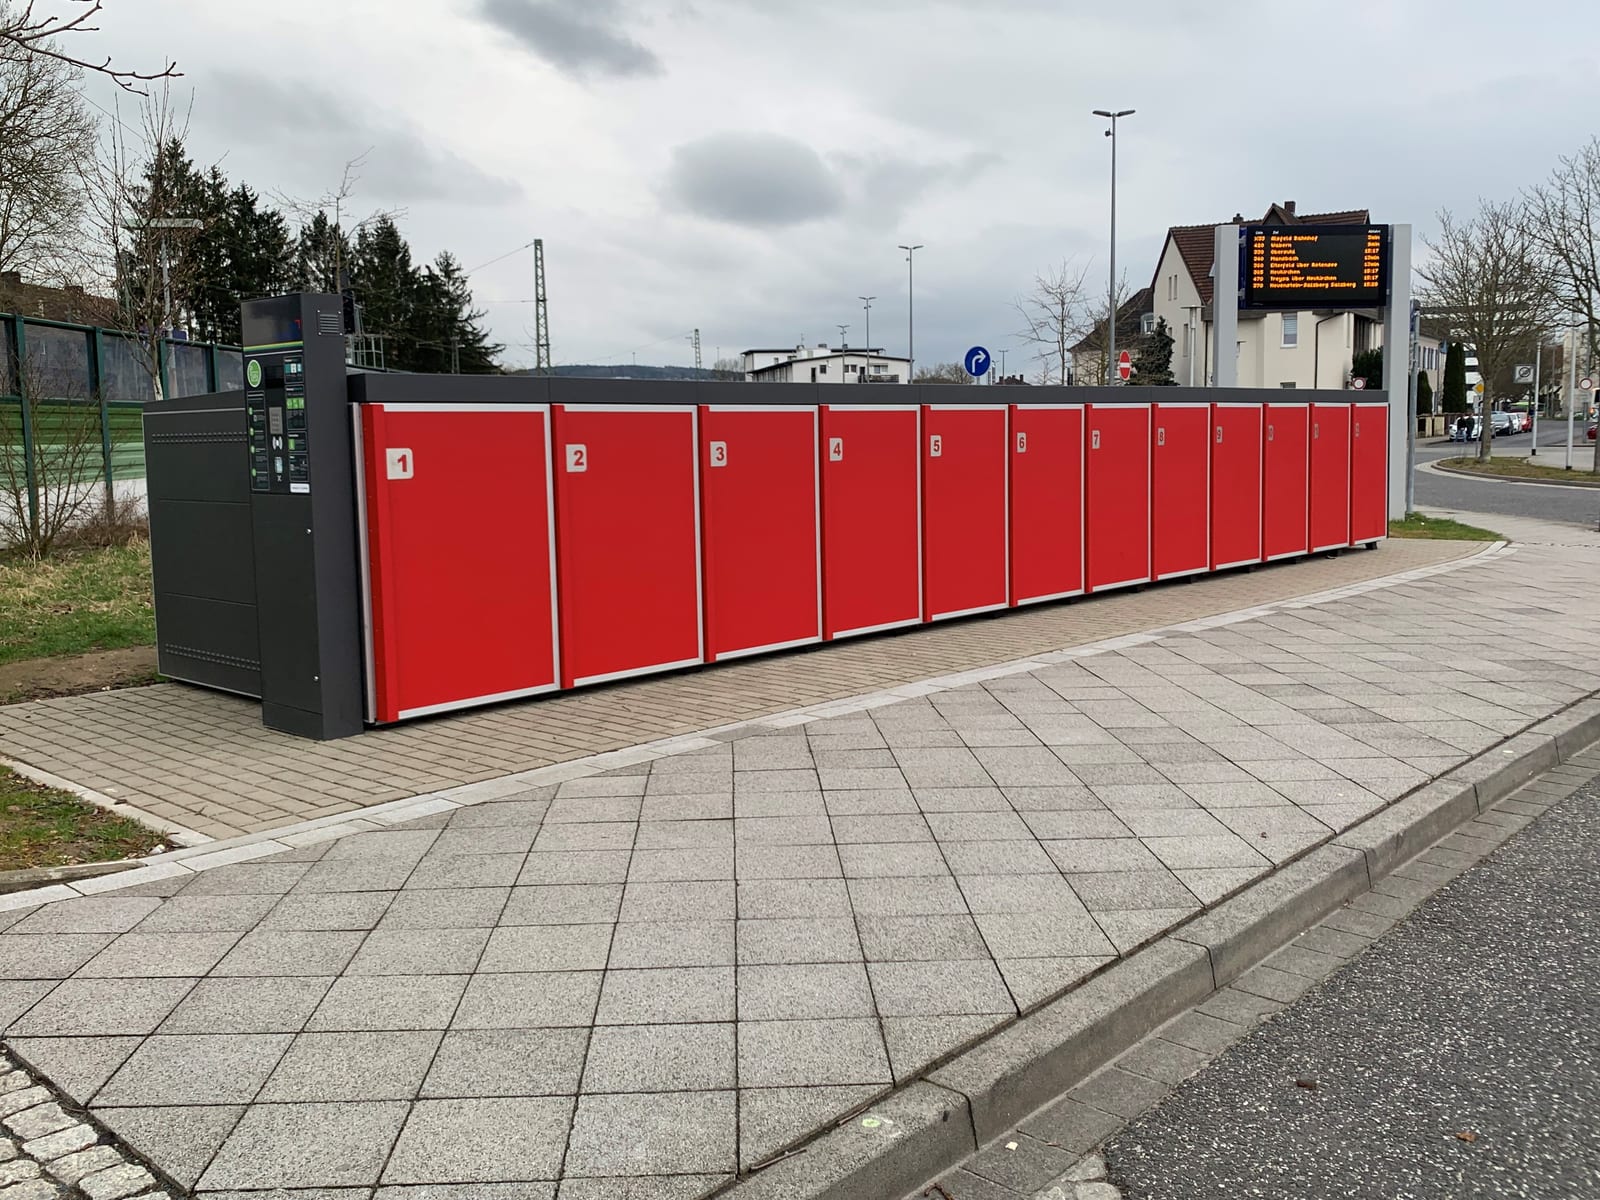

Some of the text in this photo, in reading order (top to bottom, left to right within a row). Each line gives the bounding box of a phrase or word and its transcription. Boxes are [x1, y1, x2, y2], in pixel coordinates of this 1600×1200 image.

[933, 439, 940, 452] 5
[1019, 437, 1025, 449] 6
[1093, 434, 1099, 445] 7
[715, 446, 725, 461] 3
[832, 442, 841, 457] 4
[397, 454, 408, 473] 1
[573, 450, 585, 466] 2
